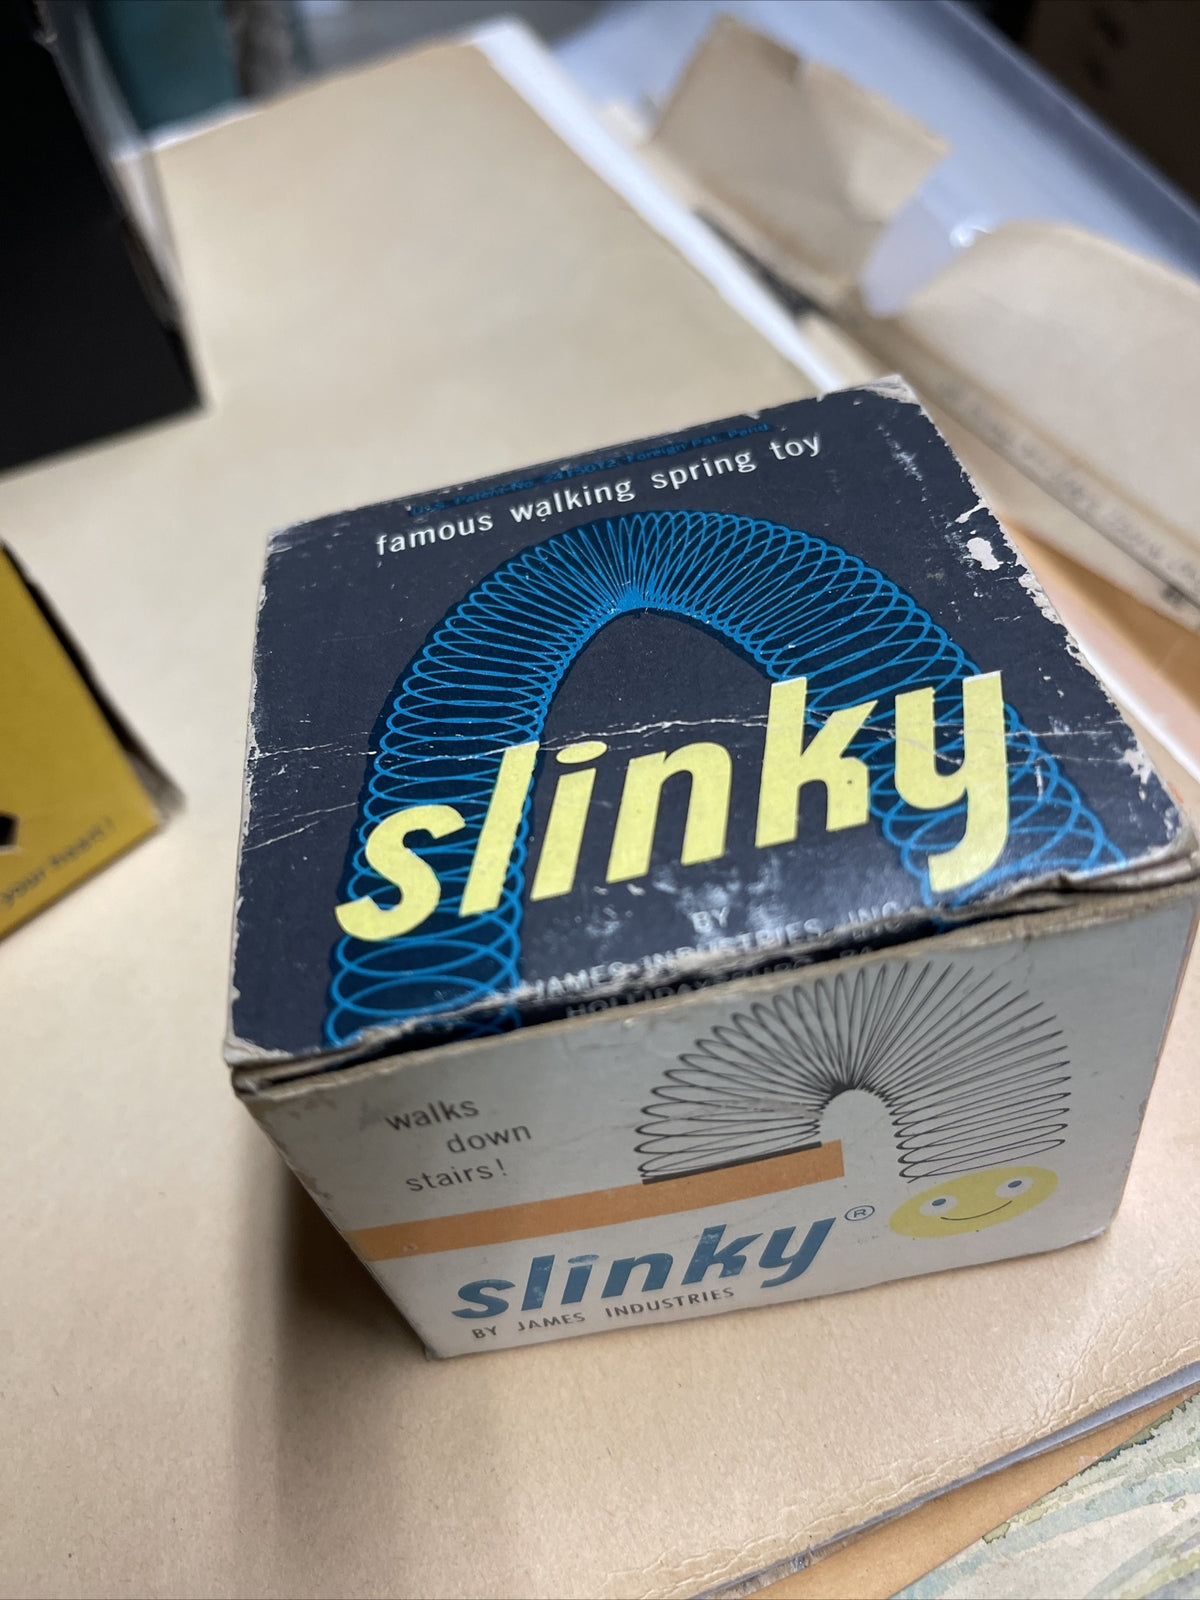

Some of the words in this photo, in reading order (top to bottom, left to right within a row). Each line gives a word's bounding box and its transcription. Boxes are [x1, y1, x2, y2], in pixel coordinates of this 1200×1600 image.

[376, 513, 494, 556] famous
[510, 477, 636, 523] walking
[651, 449, 758, 490] spring
[768, 433, 822, 461] toy
[335, 670, 1009, 941] slinky
[692, 907, 730, 930] BY
[384, 1099, 480, 1132] walks
[447, 1122, 533, 1155] down
[406, 1160, 508, 1192] stairs!
[451, 1217, 837, 1320] slinky
[473, 1325, 498, 1340] BY
[517, 1312, 586, 1332] JAMES
[605, 1287, 735, 1319] INDUSTRIES
